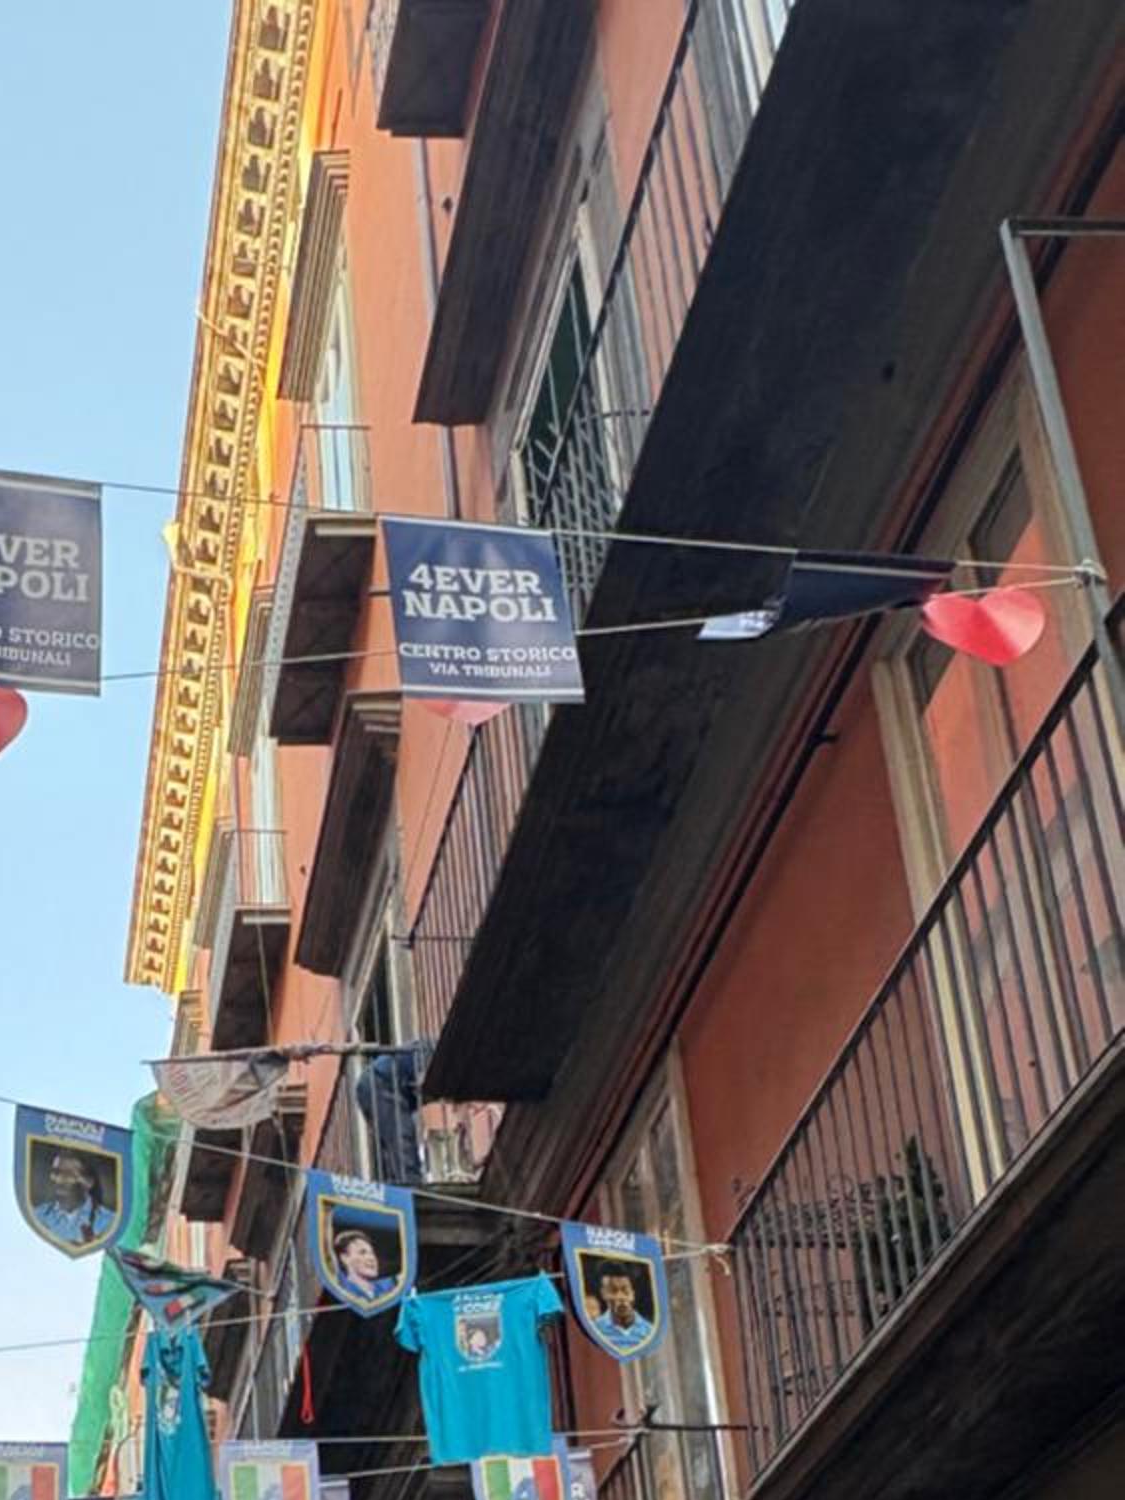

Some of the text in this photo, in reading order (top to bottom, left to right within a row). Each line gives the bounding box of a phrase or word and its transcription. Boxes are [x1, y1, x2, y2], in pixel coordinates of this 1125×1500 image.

[409, 563, 543, 596] 4EVER
[402, 590, 558, 622] NAPOLI
[9, 626, 99, 650] STORICO
[399, 642, 576, 662] CENTRO STORICO
[429, 662, 552, 678] VIA TRIBUNALI
